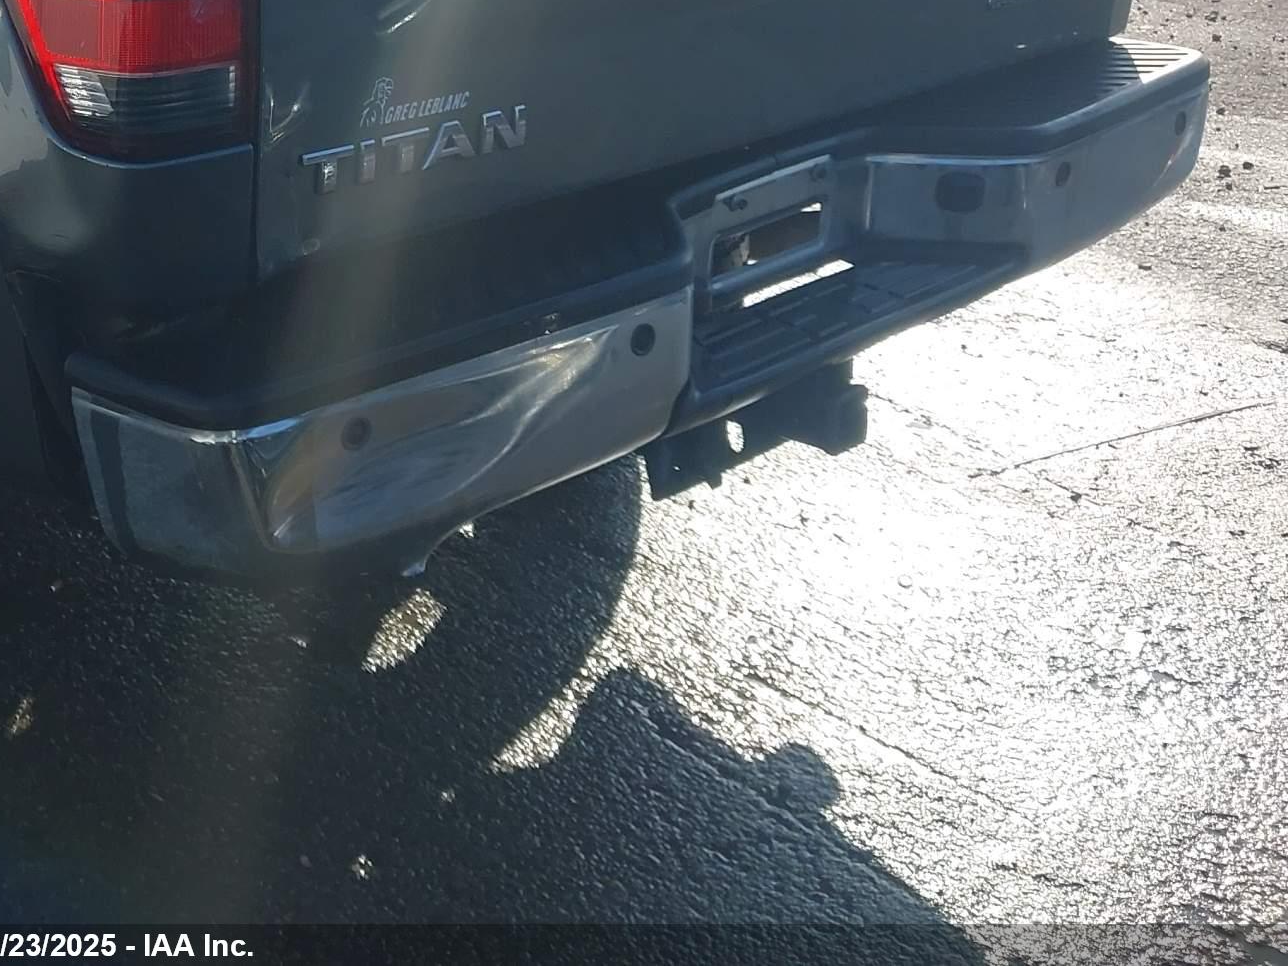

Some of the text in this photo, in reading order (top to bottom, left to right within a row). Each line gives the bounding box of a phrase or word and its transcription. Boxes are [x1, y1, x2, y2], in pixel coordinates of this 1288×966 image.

[385, 91, 471, 125] GREG LEBLANC
[299, 105, 527, 195] TITAN
